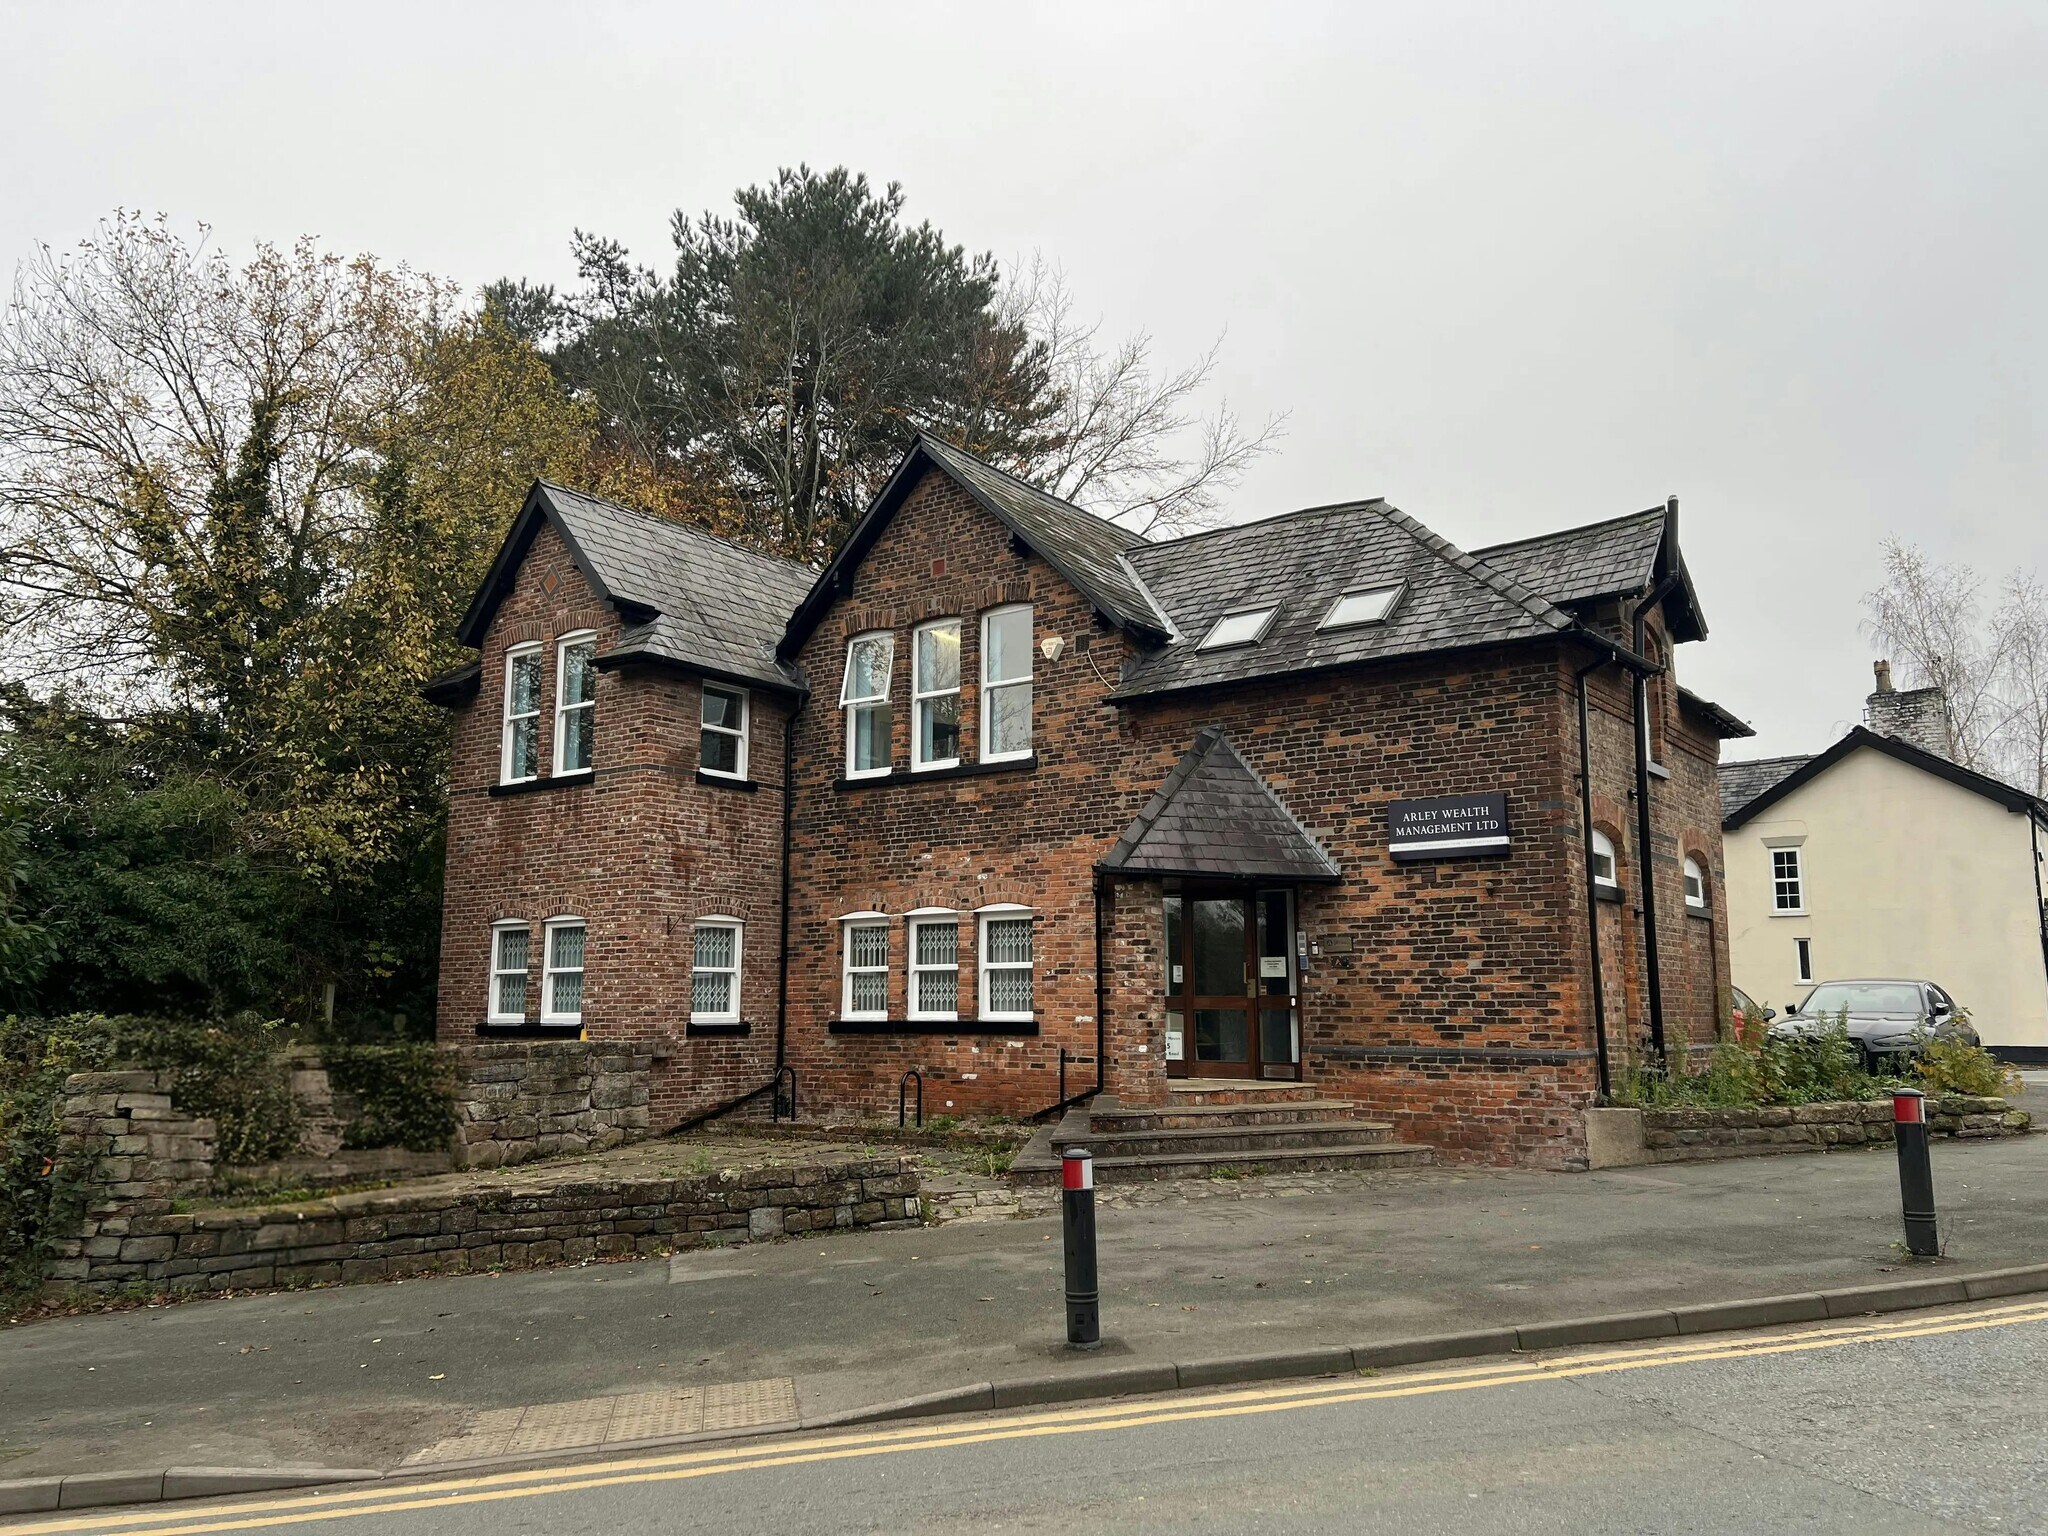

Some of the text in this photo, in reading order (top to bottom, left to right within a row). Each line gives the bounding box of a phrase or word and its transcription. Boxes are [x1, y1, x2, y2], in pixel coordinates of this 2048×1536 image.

[1402, 806, 1489, 822] ARLEY WEALTH
[1396, 820, 1499, 836] MANAGEMENT LTD
